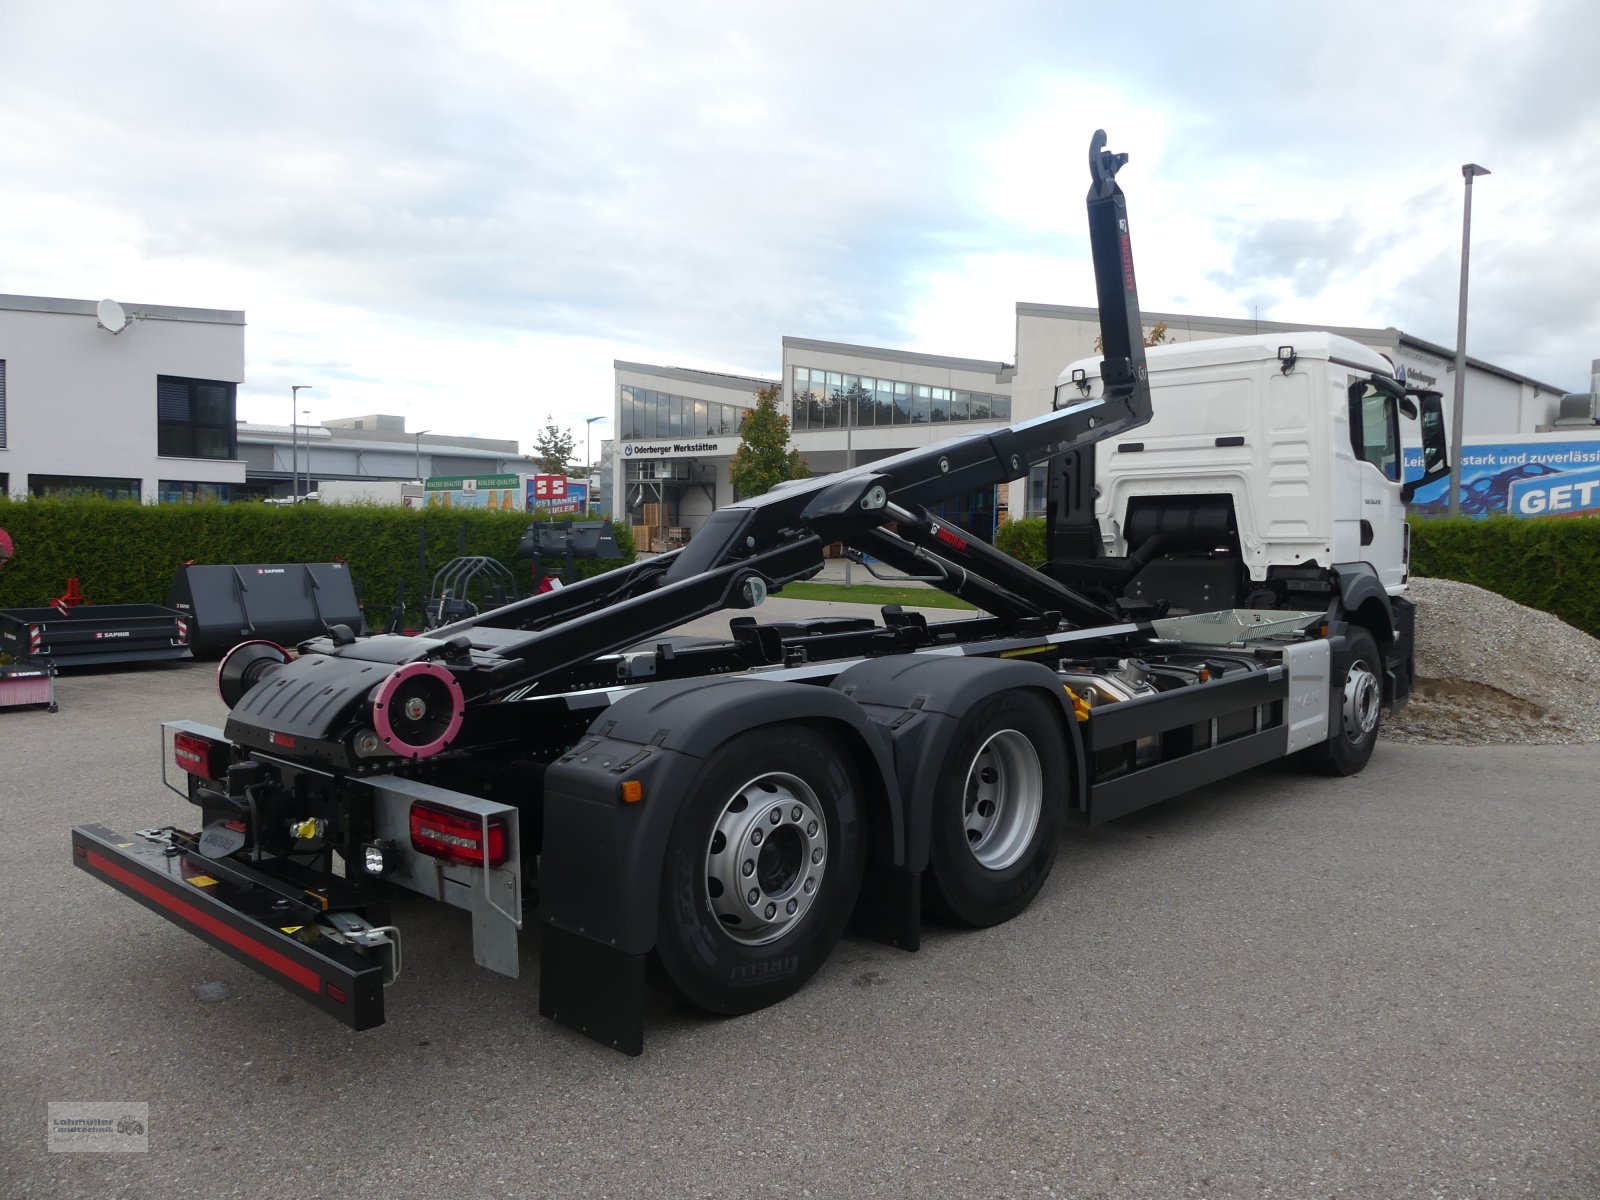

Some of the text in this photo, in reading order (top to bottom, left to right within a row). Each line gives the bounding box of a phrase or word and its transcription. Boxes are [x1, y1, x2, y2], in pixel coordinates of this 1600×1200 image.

[634, 443, 718, 455] Oderberger Werkstätten
[1500, 453, 1526, 464] und
